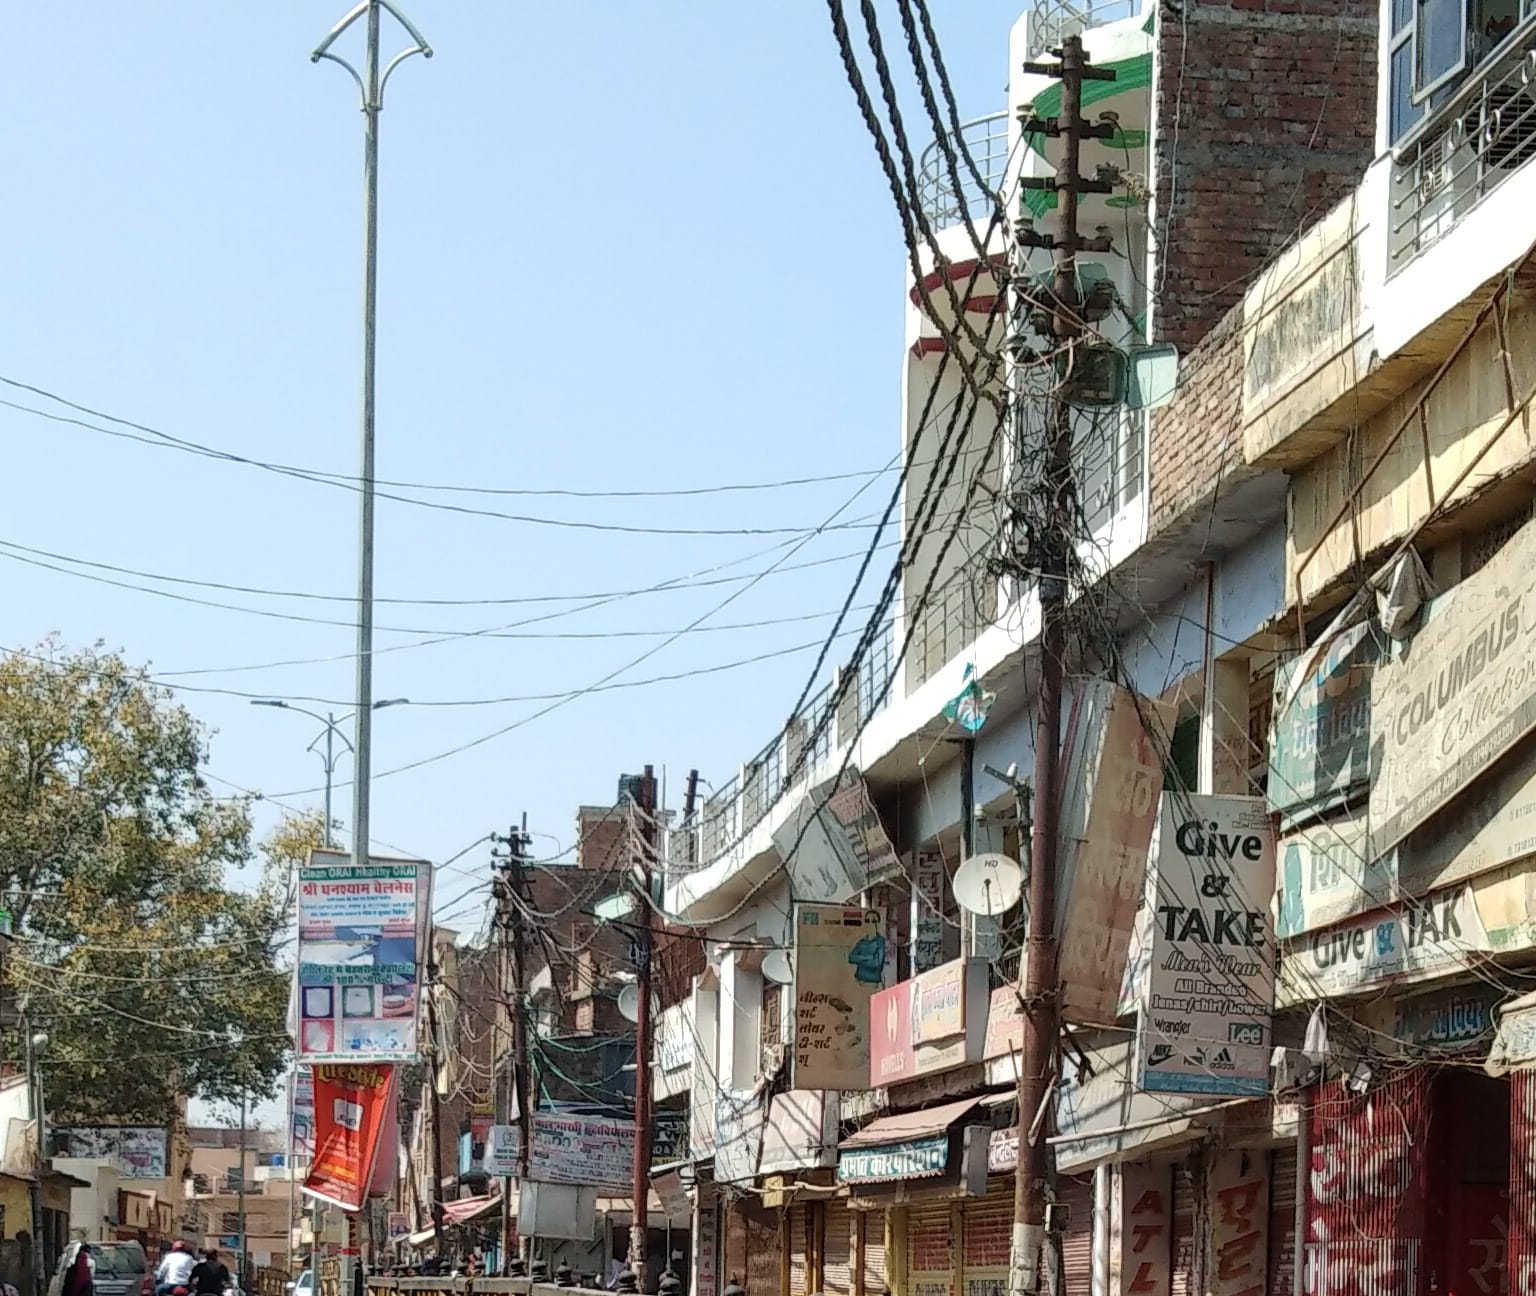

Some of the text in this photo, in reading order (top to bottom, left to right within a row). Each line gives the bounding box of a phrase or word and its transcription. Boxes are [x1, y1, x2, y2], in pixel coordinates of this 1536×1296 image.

[1394, 600, 1522, 747] COLUMBUS
[1175, 820, 1263, 862] Give
[301, 883, 318, 897] श्री
[1200, 873, 1231, 900] &
[1157, 905, 1267, 948] TAKE
[1313, 924, 1365, 970] Give
[1230, 1023, 1263, 1045] Lee
